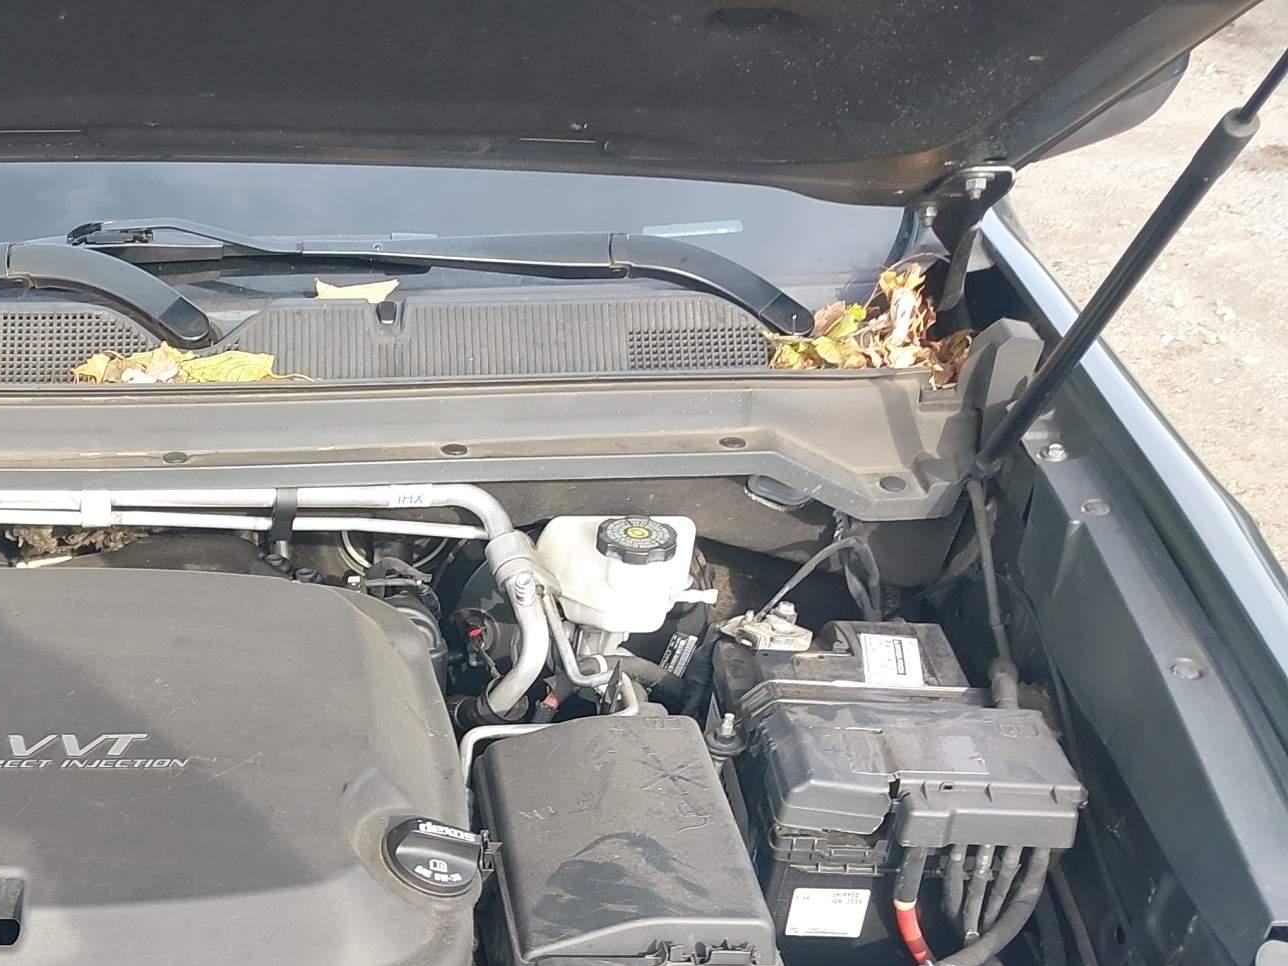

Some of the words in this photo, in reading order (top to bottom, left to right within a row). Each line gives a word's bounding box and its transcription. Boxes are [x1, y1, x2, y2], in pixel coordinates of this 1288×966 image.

[7, 733, 149, 758] VVT
[61, 757, 190, 769] INJECTION
[418, 821, 476, 842] dexos
